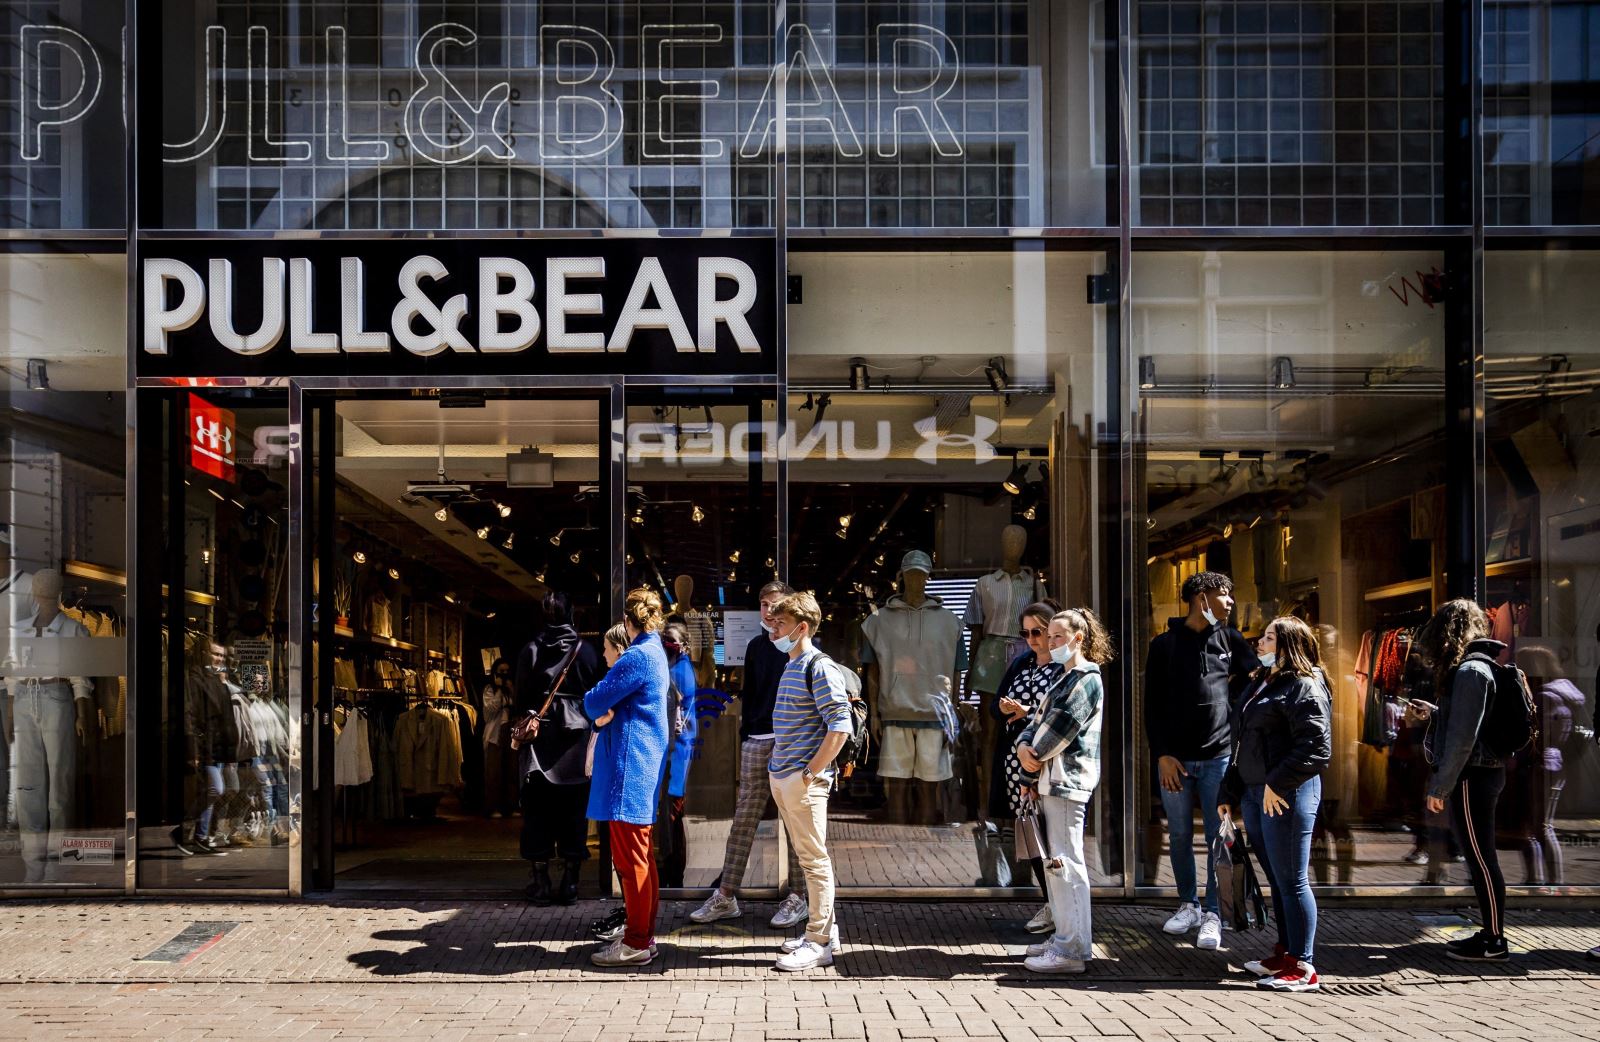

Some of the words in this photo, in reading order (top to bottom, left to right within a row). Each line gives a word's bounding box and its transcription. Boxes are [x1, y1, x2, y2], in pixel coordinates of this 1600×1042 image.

[143, 254, 762, 357] PULL&BEAR
[63, 840, 83, 848] ALARM
[84, 840, 112, 848] SYSTEEM
